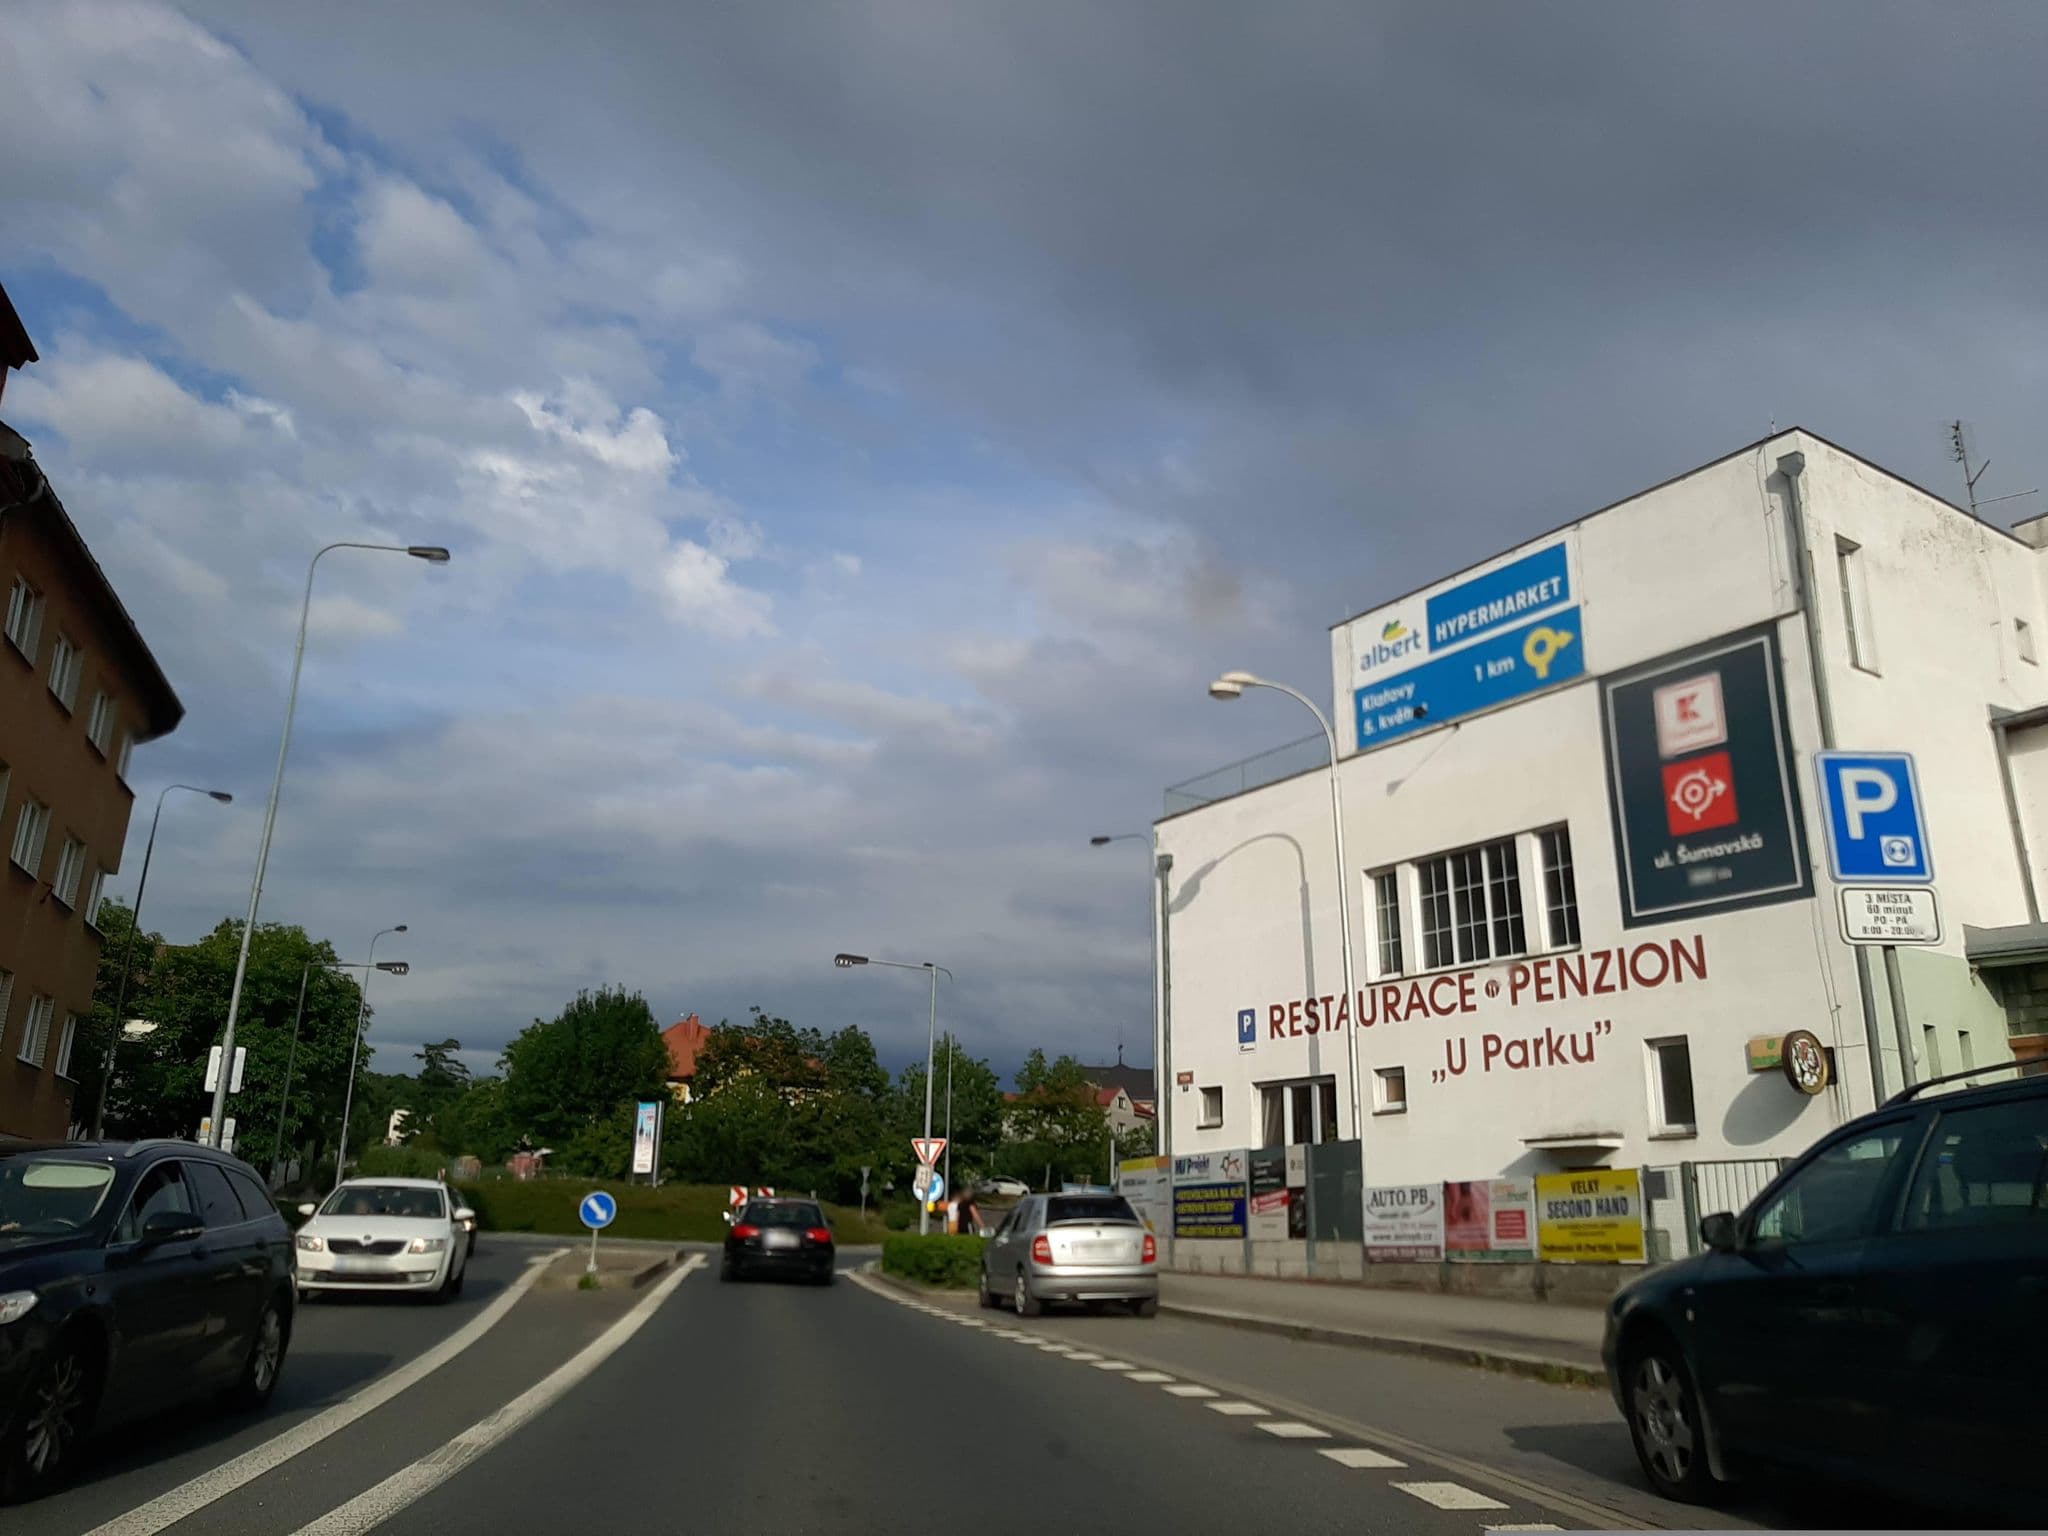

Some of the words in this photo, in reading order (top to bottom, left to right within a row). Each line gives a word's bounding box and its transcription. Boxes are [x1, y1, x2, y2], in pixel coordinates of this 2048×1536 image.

[1435, 576, 1562, 642] HYPERMARKET
[1360, 629, 1421, 671] albert
[1474, 664, 1483, 683] 1
[1486, 656, 1515, 678] km
[1362, 682, 1415, 712] Klatovy
[1838, 767, 1897, 840] P
[1654, 851, 1674, 869] ul.
[1677, 832, 1763, 865] Šumavská
[1865, 894, 1872, 904] 3
[1867, 904, 1880, 914] 60
[1883, 905, 1913, 914] minut
[1874, 915, 1887, 925] PO
[1269, 972, 1477, 1040] RESTAURACE
[1509, 935, 1707, 1006] PENZION
[1243, 1014, 1252, 1033] P
[1547, 1199, 1592, 1219] SECOND
[1595, 1196, 1629, 1217] HAND
